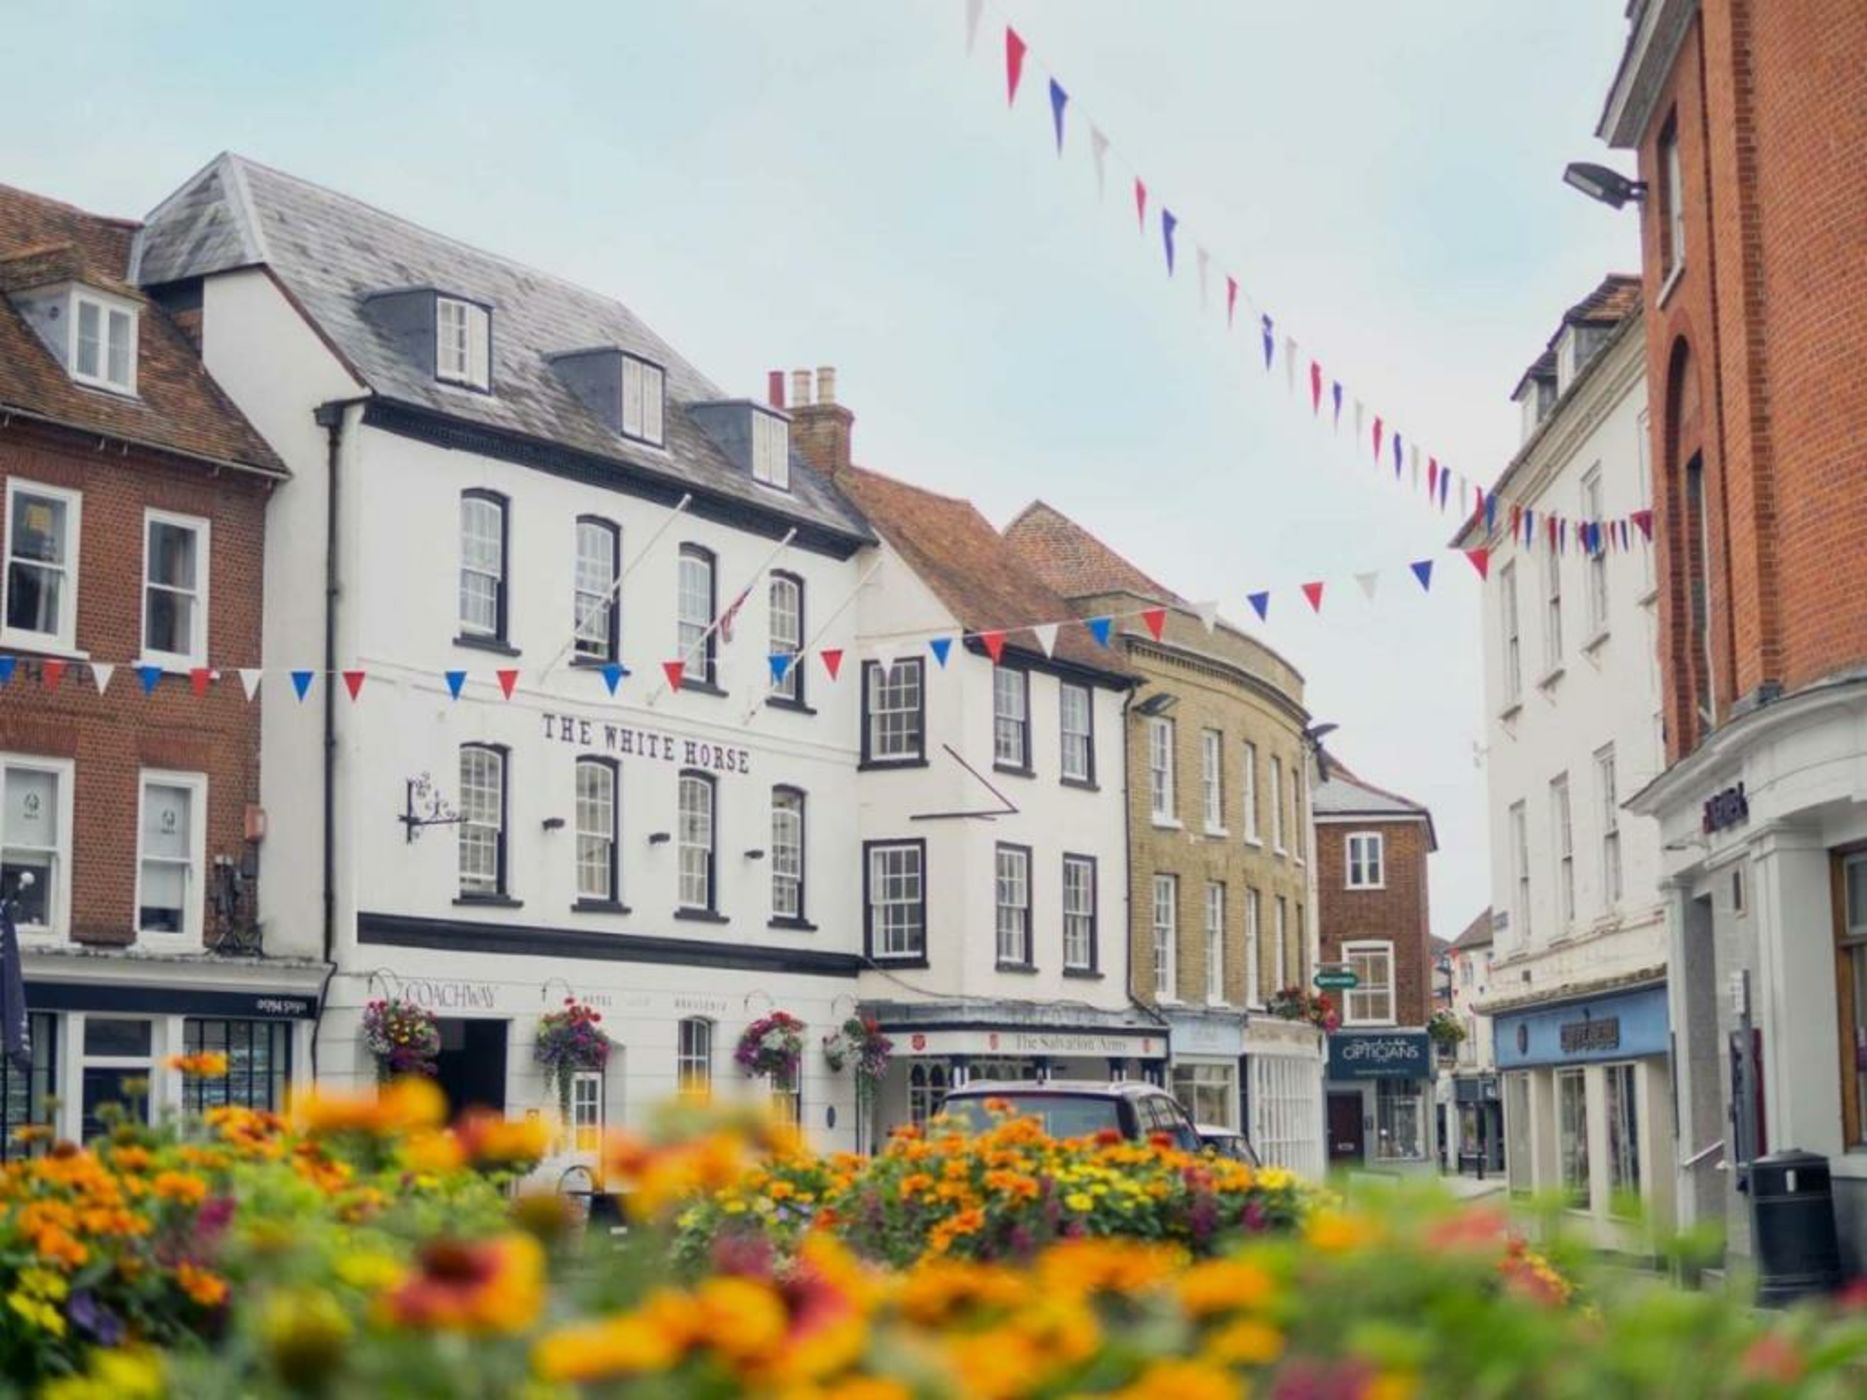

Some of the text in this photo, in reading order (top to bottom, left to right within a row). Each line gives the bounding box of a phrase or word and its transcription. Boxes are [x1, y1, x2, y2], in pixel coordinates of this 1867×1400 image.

[542, 713, 750, 774] THE WHITE HORSE
[1016, 1034, 1037, 1050] The
[1342, 1046, 1419, 1061] OPTICIANS
